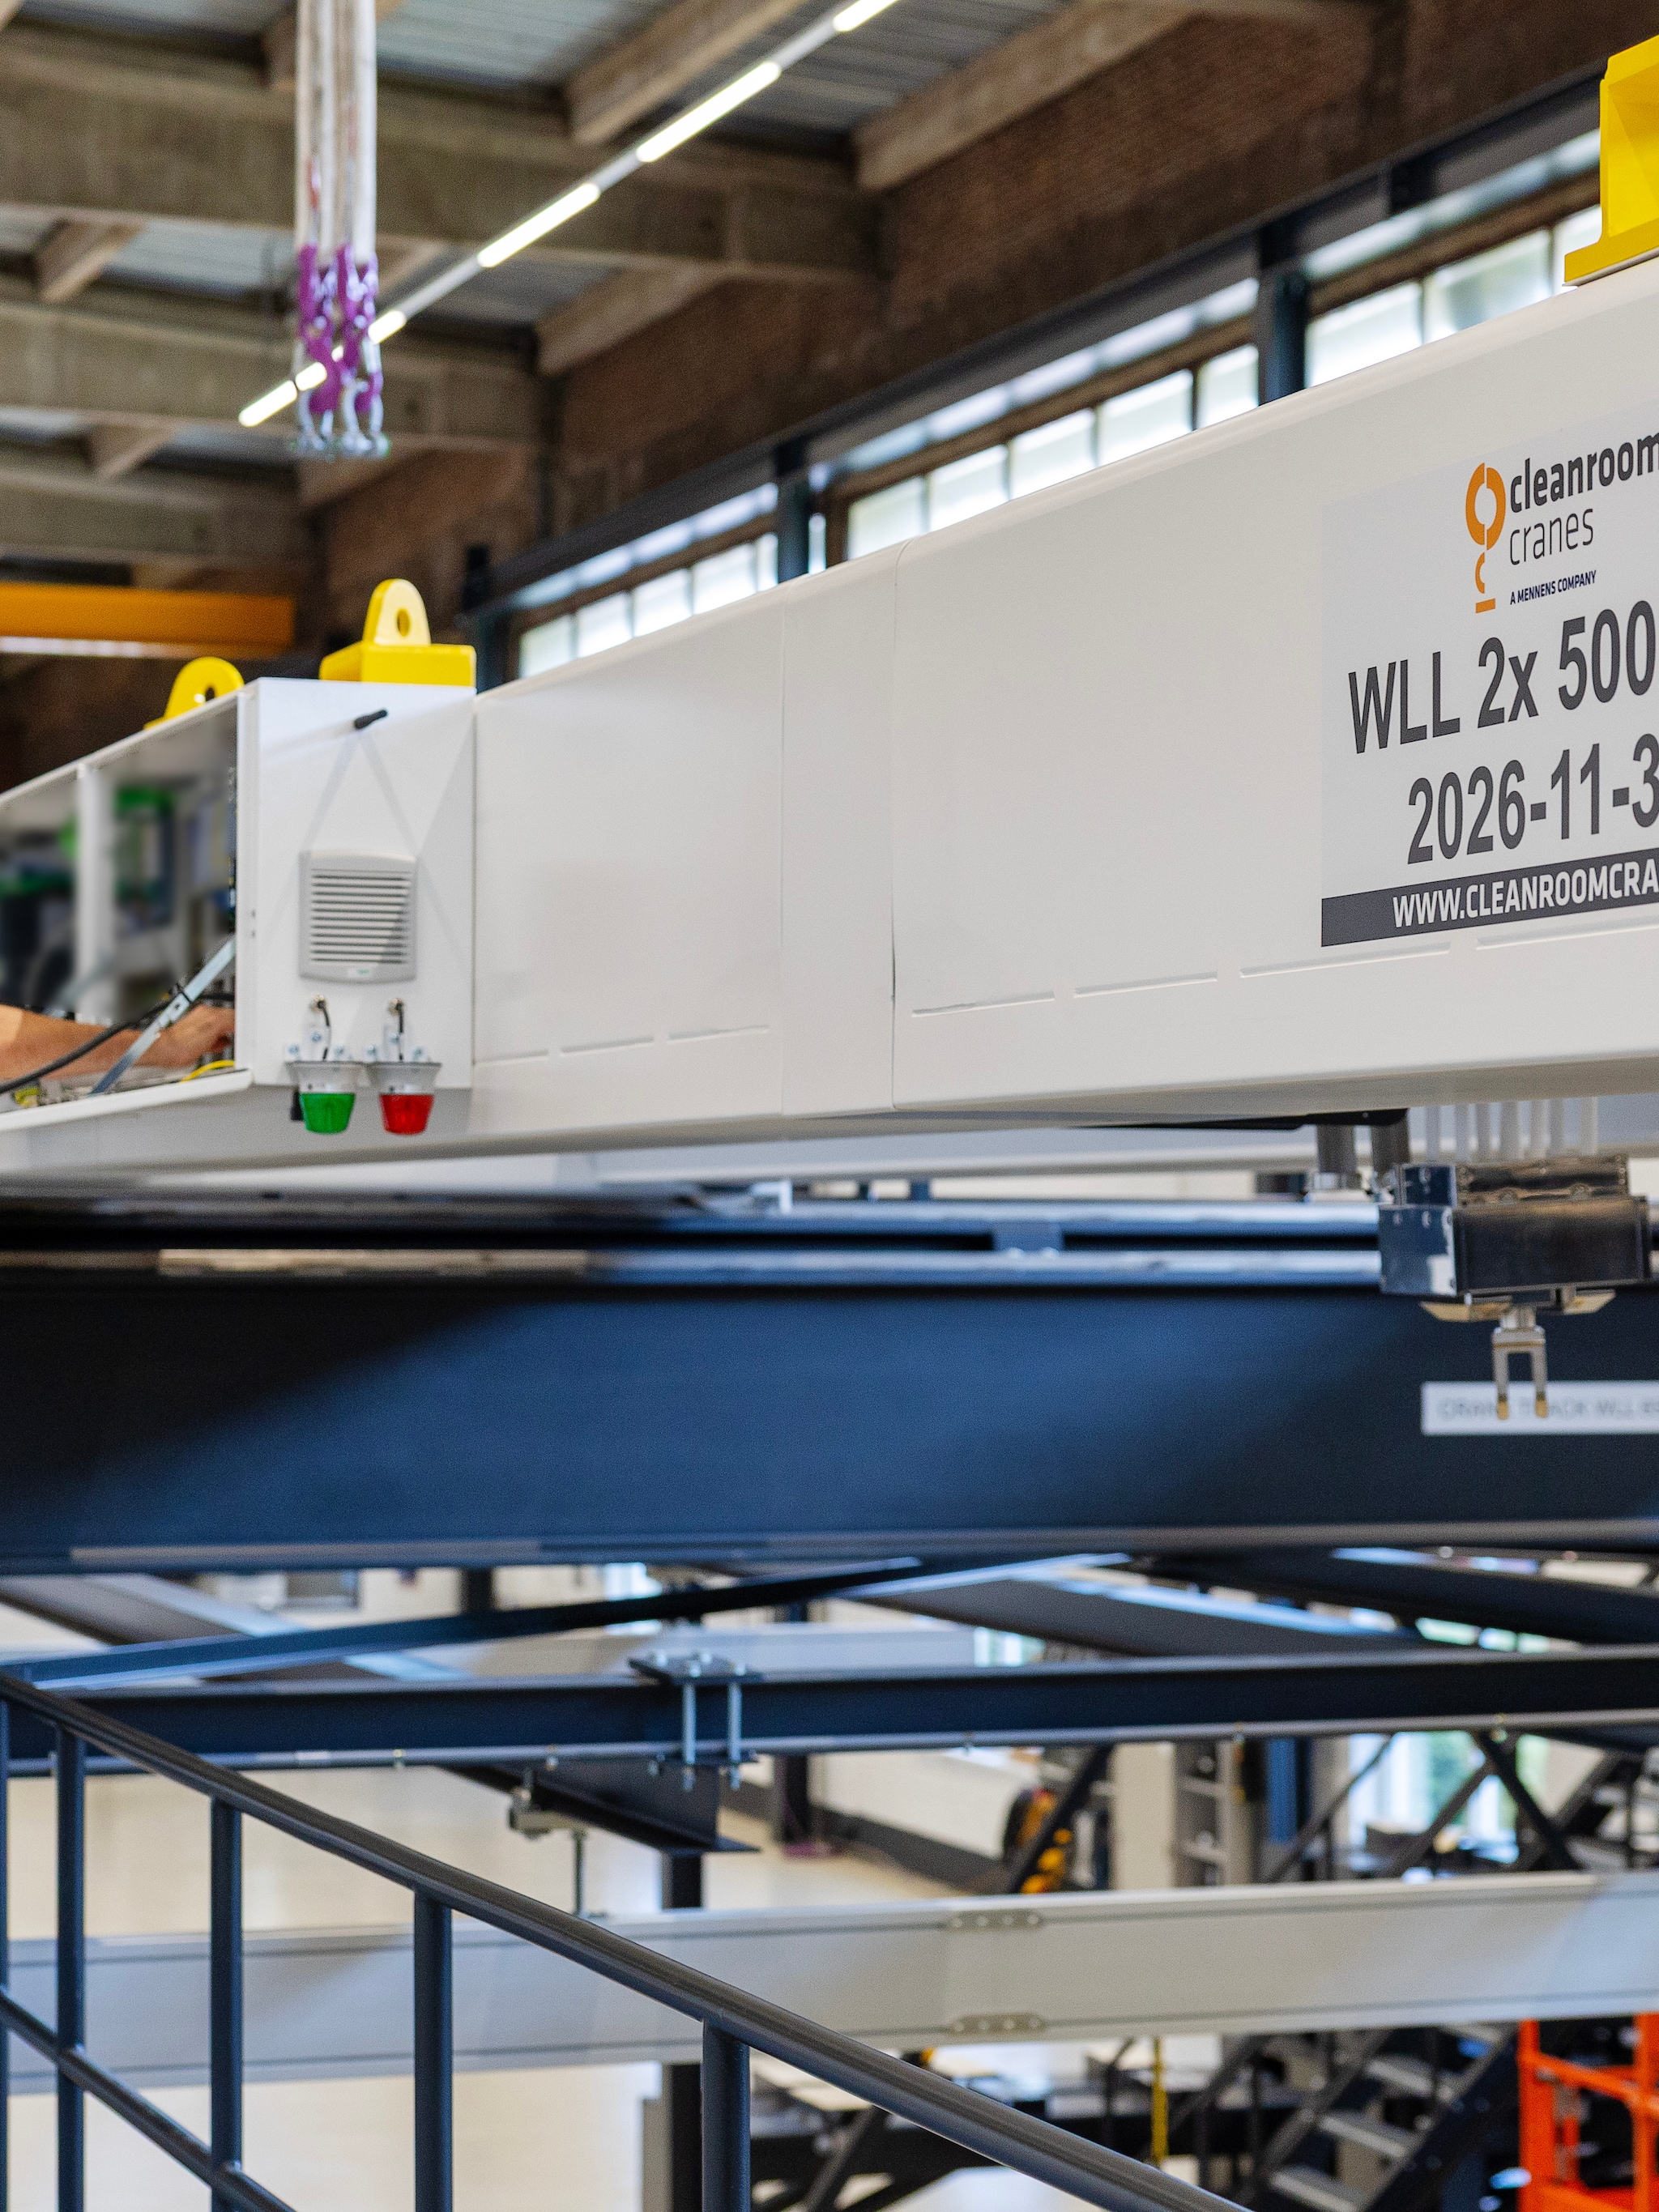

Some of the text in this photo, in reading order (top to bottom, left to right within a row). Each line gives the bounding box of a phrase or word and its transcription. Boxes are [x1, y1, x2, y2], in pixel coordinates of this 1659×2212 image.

[1510, 432, 1659, 514] cleanroom
[1509, 509, 1594, 565] cranes
[1510, 569, 1597, 605] A MENNENS COMPANY
[1348, 600, 1657, 754] WLL 2x 500
[1407, 733, 1659, 864] 2026-11-3
[1392, 859, 1659, 928] WWW.CLEANROOMCRA
